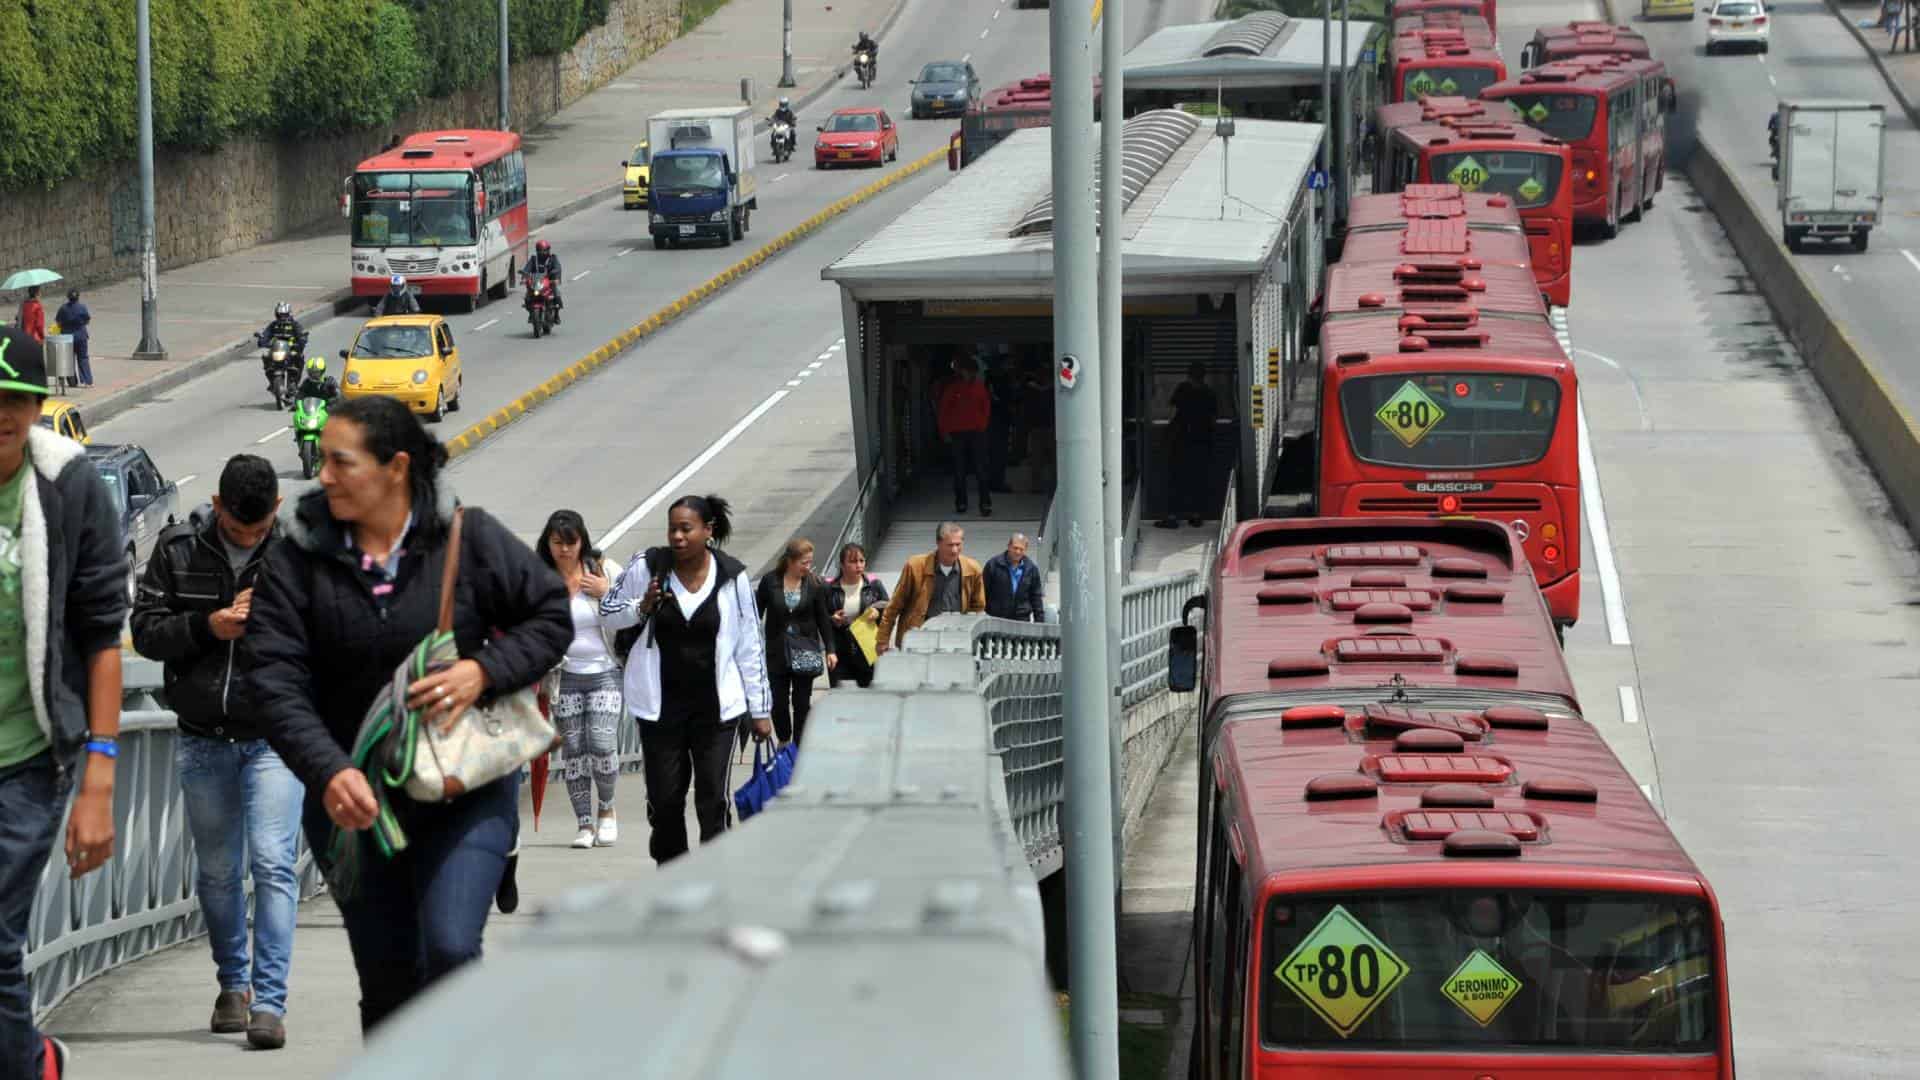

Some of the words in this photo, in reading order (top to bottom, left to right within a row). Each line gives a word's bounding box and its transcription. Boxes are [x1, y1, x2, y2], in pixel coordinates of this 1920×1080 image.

[1312, 172, 1325, 187] A
[1452, 978, 1509, 993] JERONIMO
[1472, 992, 1505, 1001] BORDO
